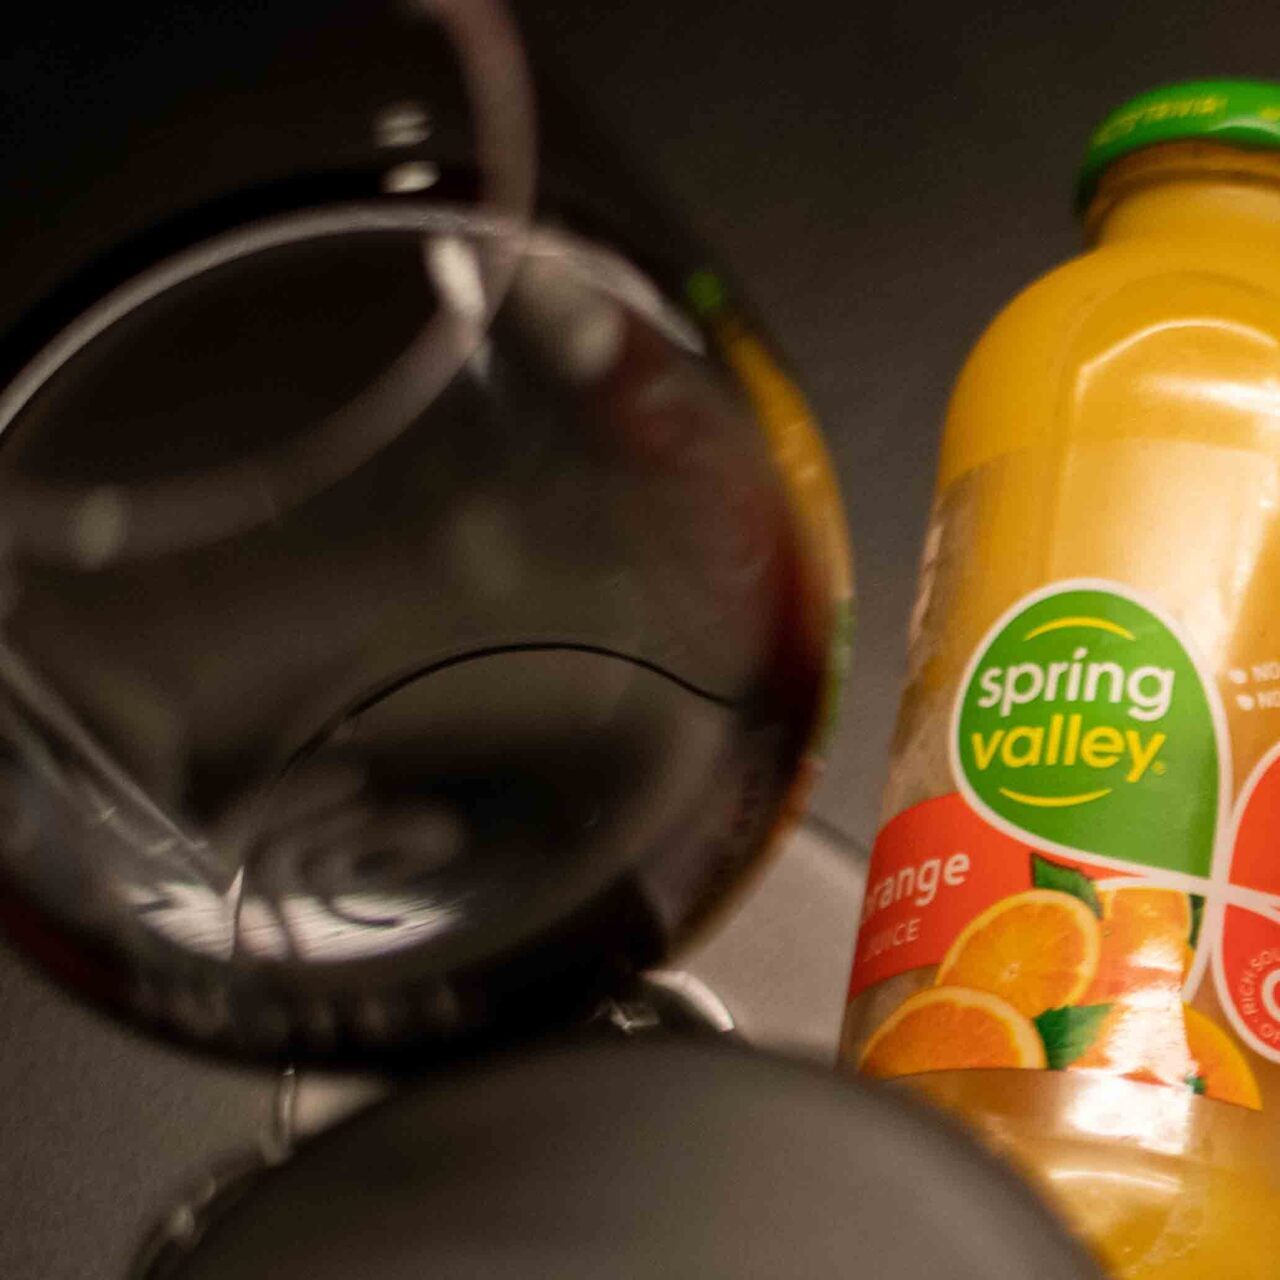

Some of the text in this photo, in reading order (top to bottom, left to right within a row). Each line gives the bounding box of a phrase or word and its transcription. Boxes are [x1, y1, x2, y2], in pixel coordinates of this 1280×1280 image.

[976, 647, 1176, 721] spring
[971, 714, 1167, 784] valley
[863, 852, 971, 918] range
